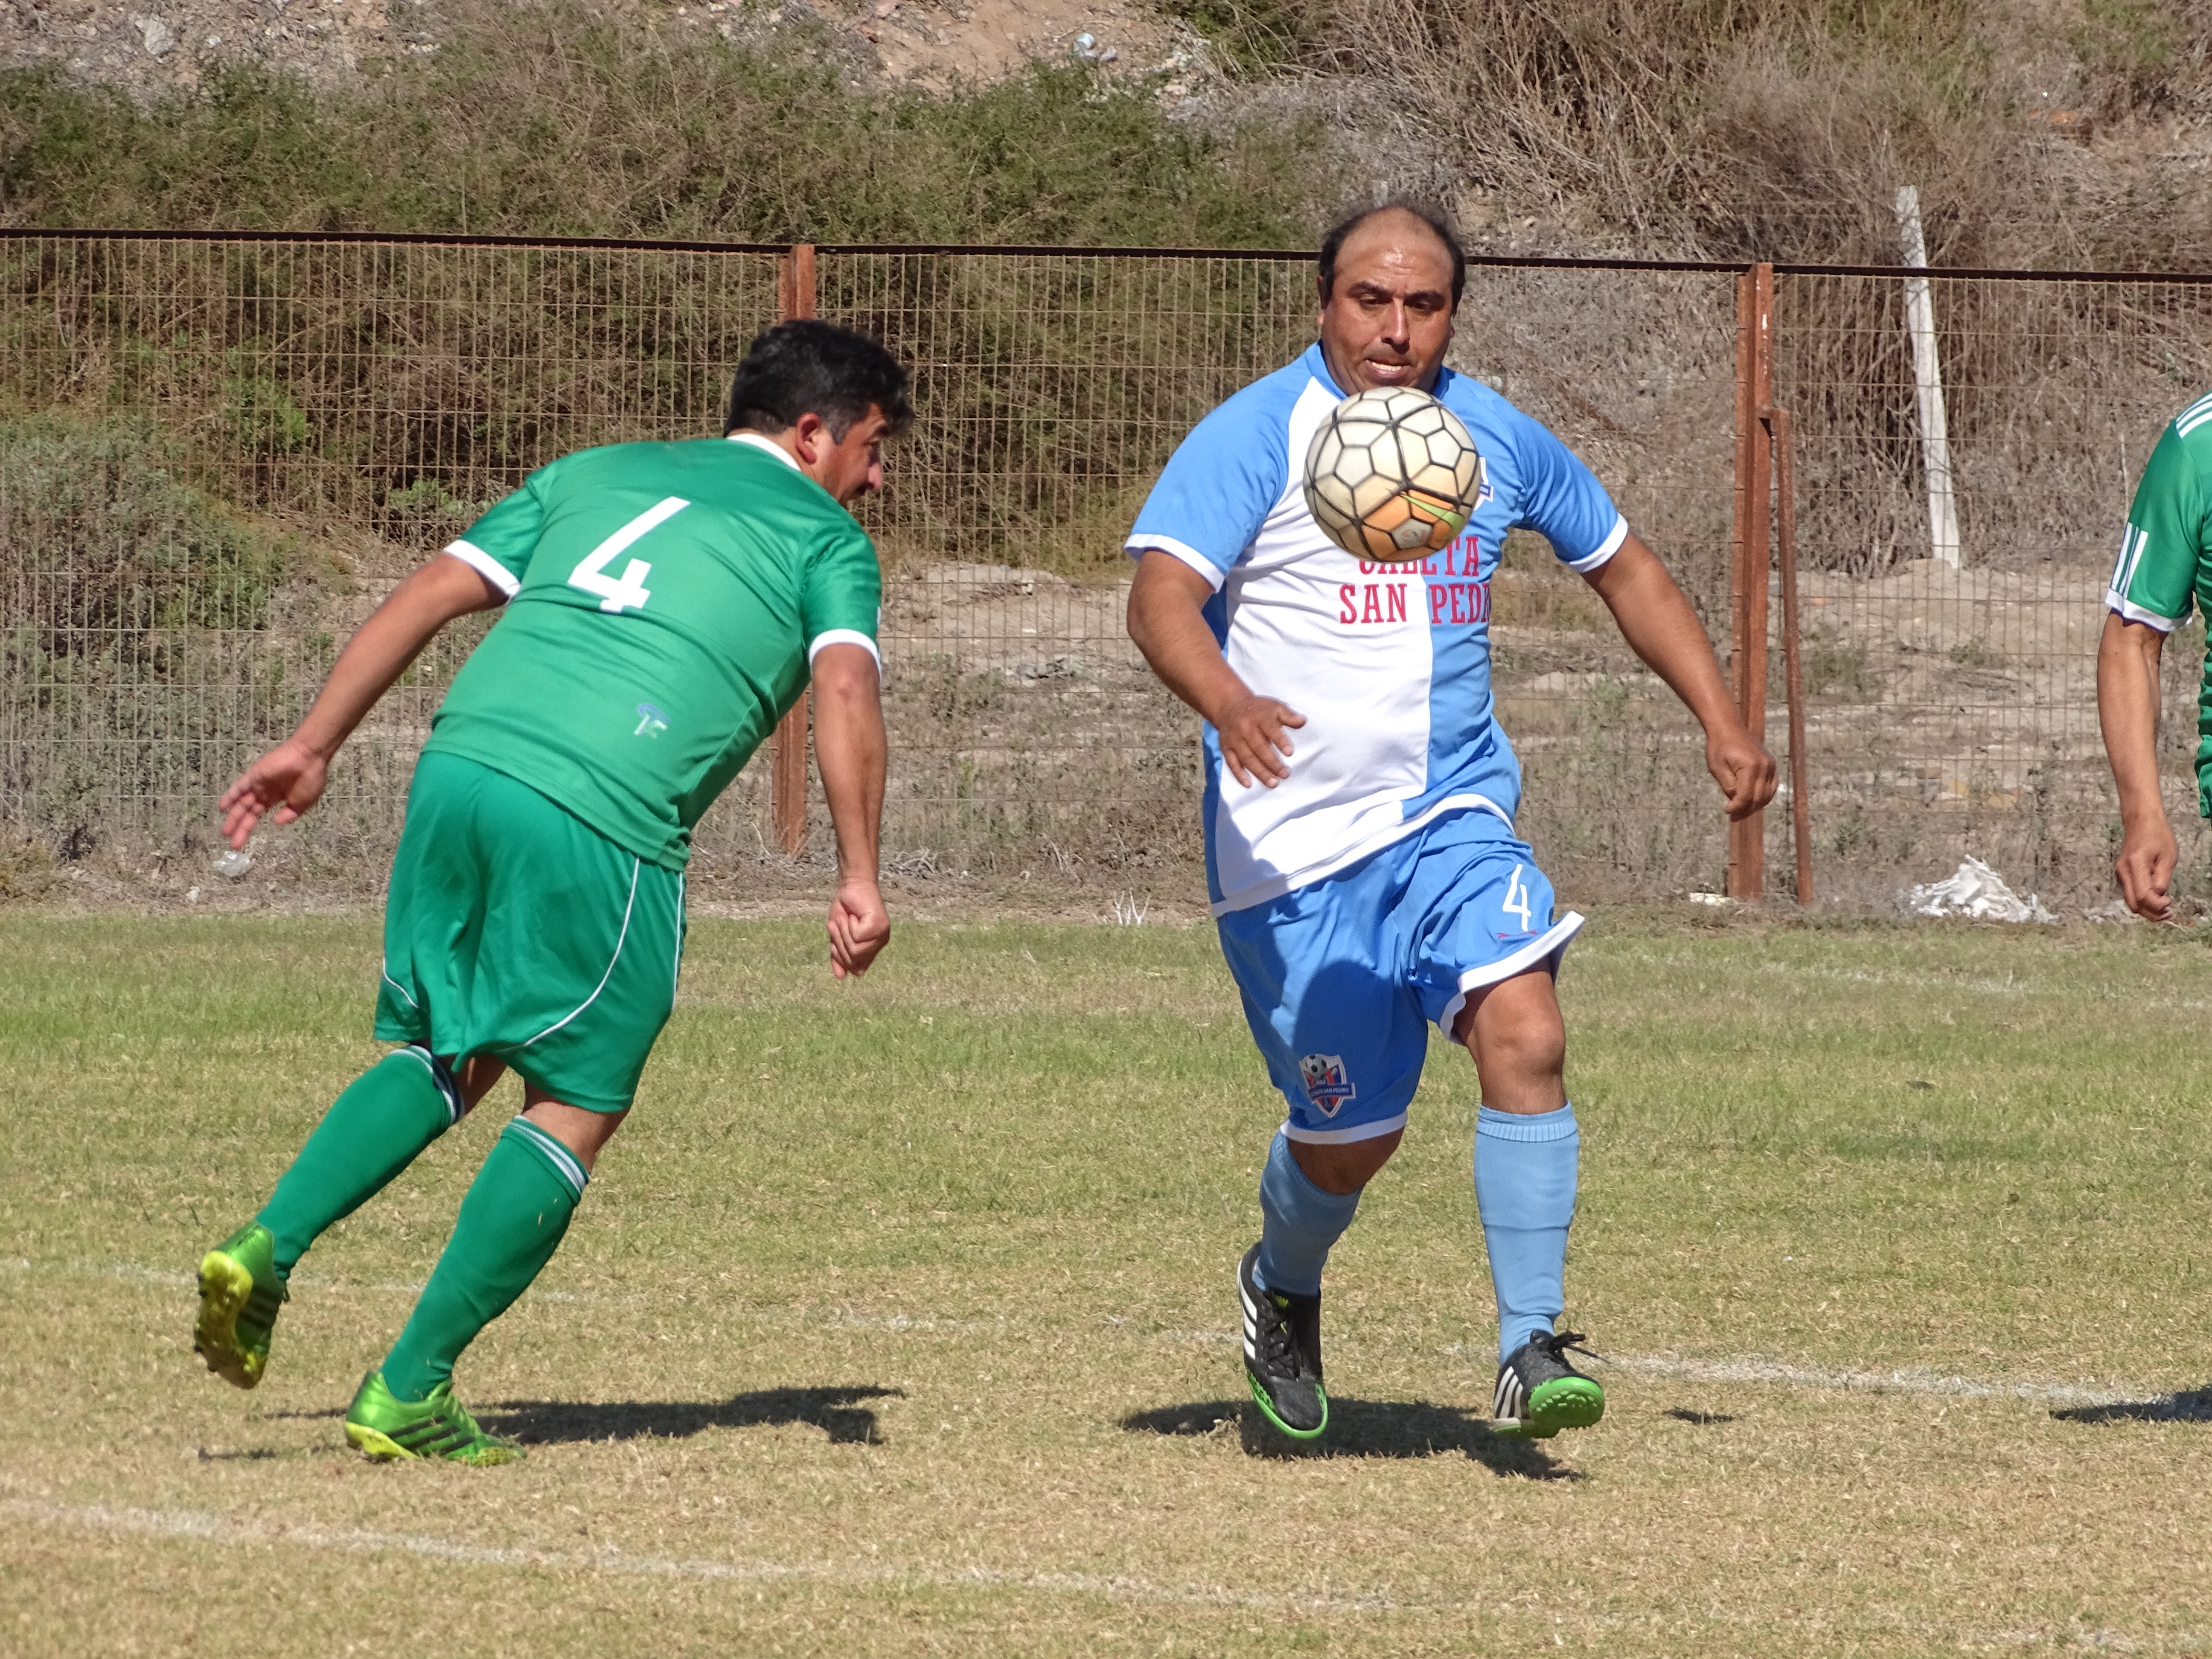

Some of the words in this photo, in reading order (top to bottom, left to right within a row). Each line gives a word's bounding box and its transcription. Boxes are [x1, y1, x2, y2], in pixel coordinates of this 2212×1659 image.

[568, 496, 691, 613] 4
[1339, 583, 1407, 624] SAN
[1502, 864, 1531, 931] 4
